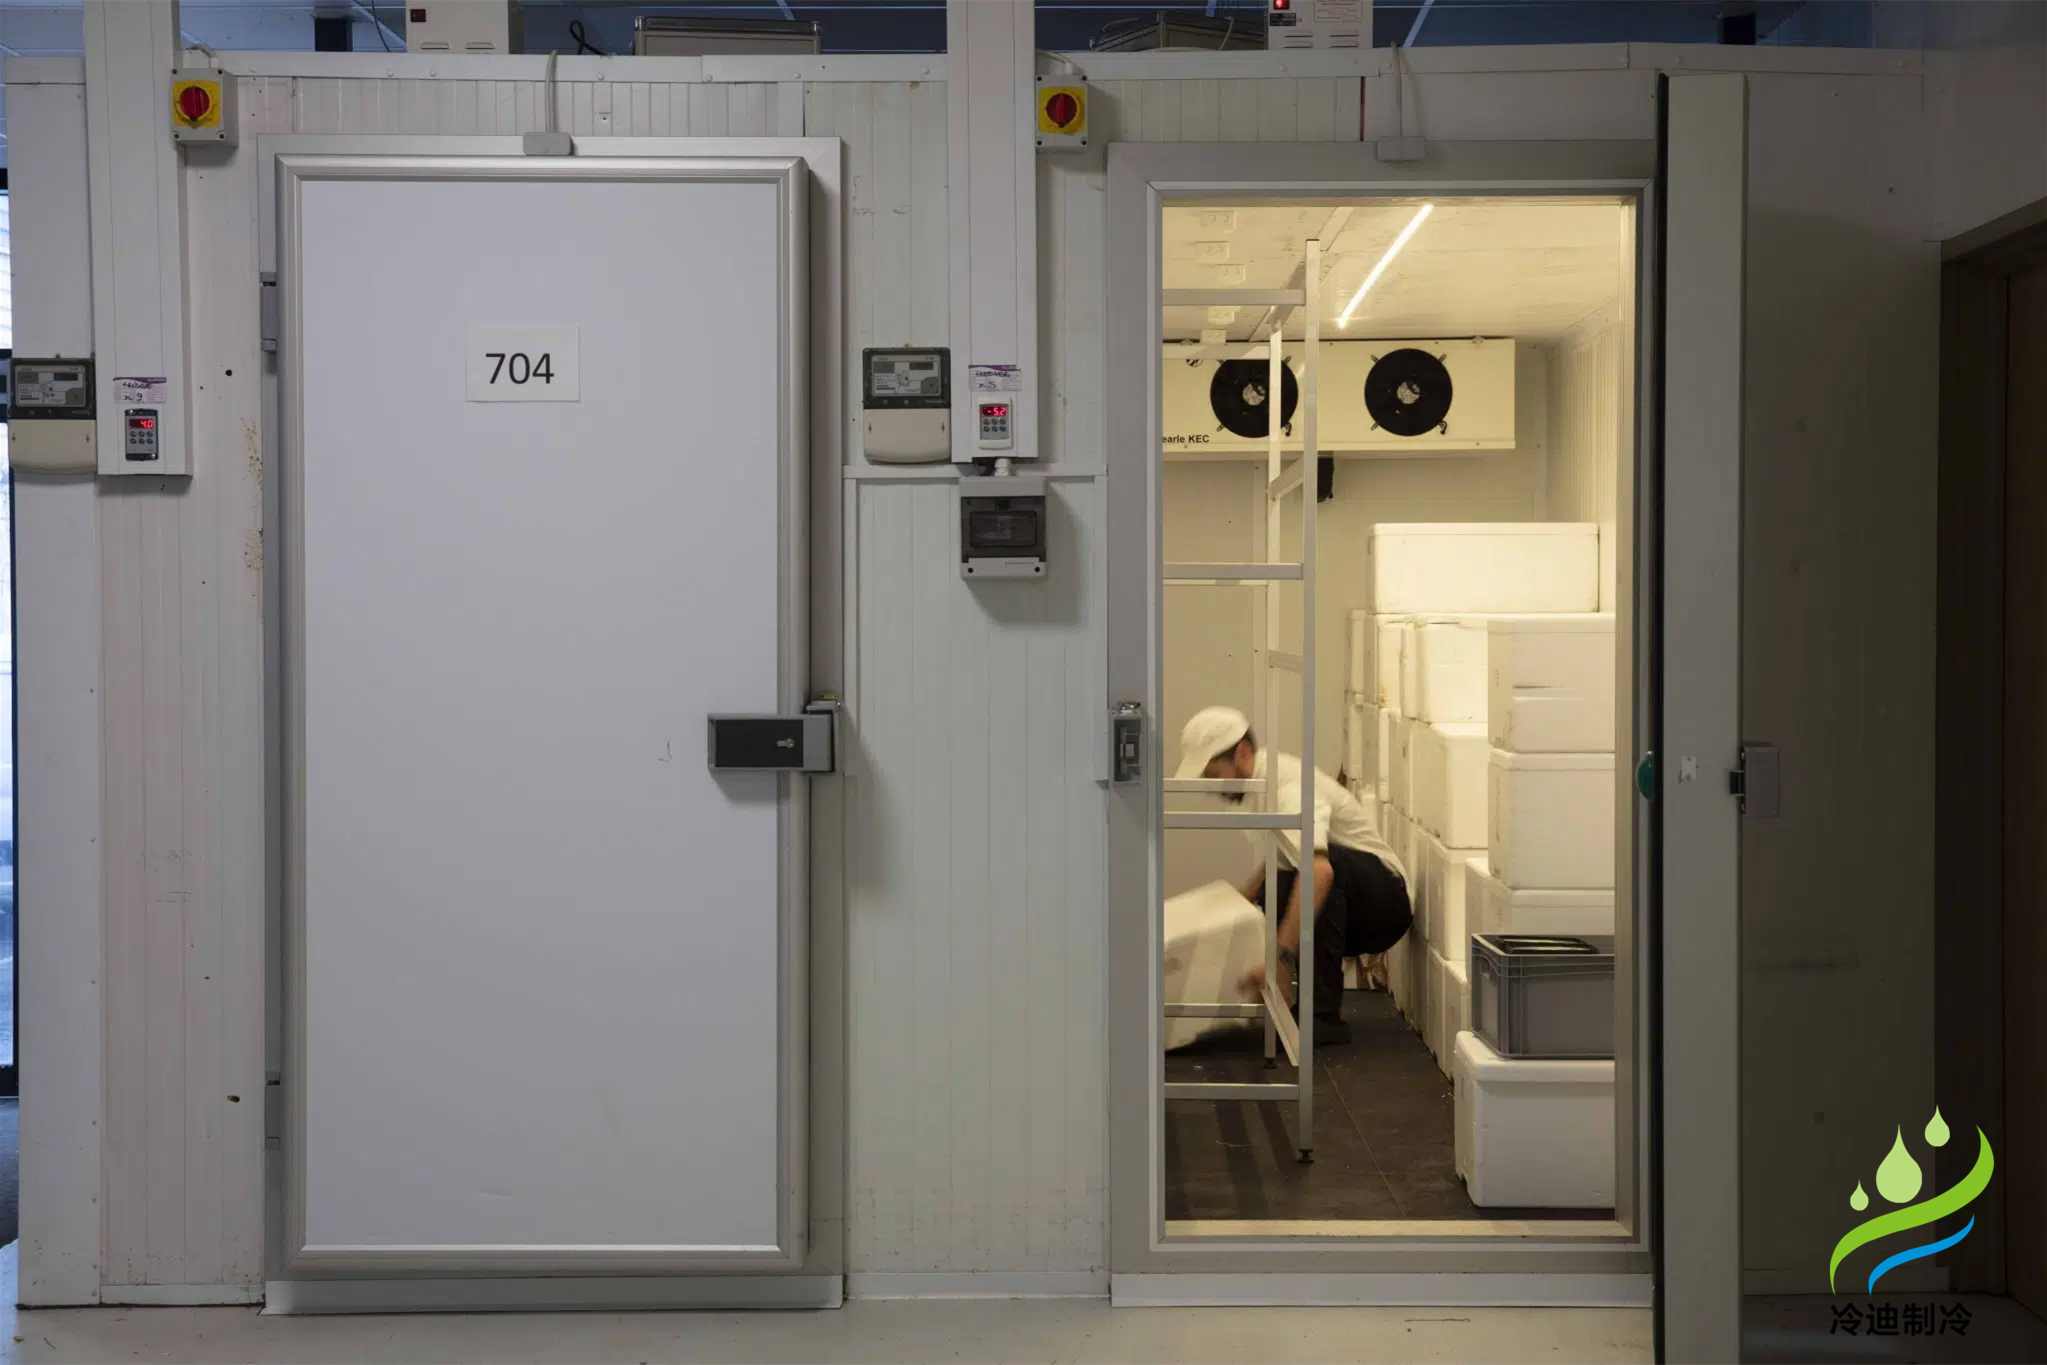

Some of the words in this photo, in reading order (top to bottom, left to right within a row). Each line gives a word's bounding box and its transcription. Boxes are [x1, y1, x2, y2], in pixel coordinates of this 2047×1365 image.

[485, 352, 555, 385] 704
[1161, 434, 1186, 443] earle
[1188, 434, 1210, 443] KEC
